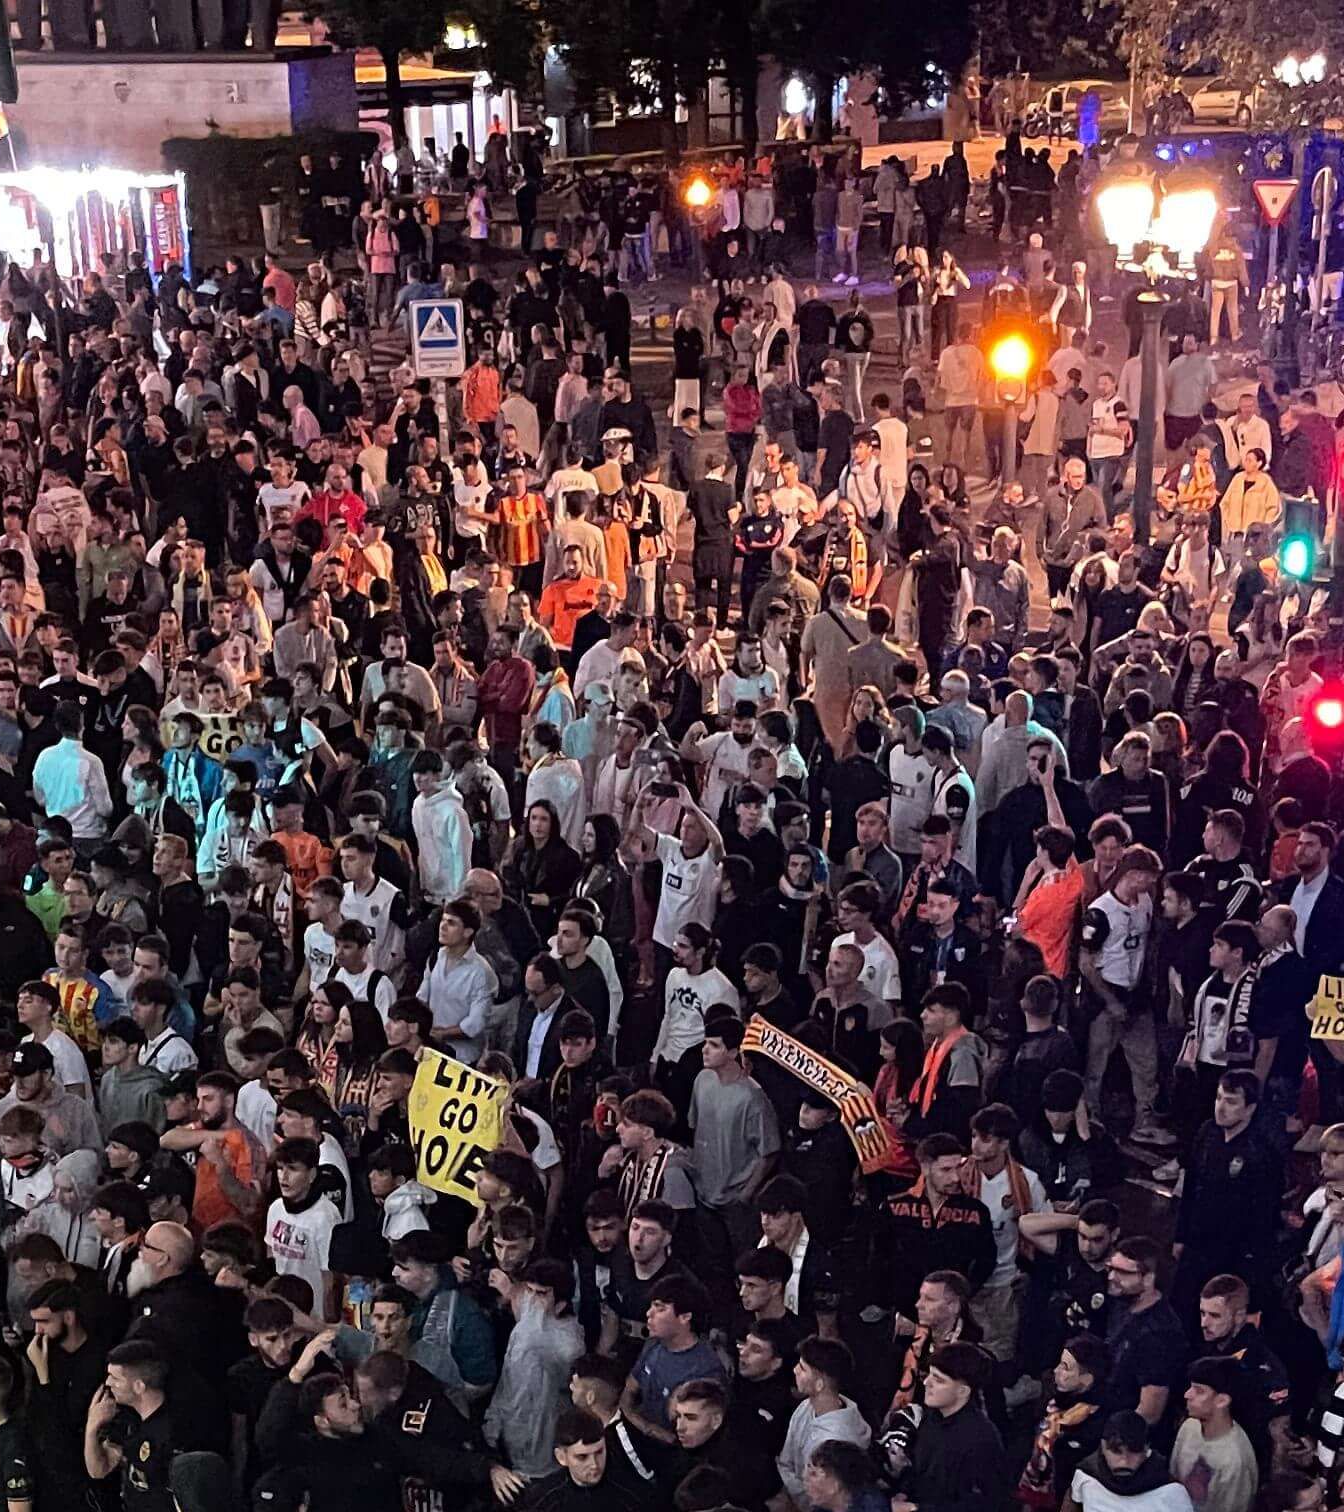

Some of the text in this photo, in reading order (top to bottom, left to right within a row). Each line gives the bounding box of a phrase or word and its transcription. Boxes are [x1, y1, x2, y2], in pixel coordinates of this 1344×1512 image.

[434, 1057, 498, 1100] LIM
[439, 1097, 478, 1134] GO
[413, 1127, 490, 1191] HOE
